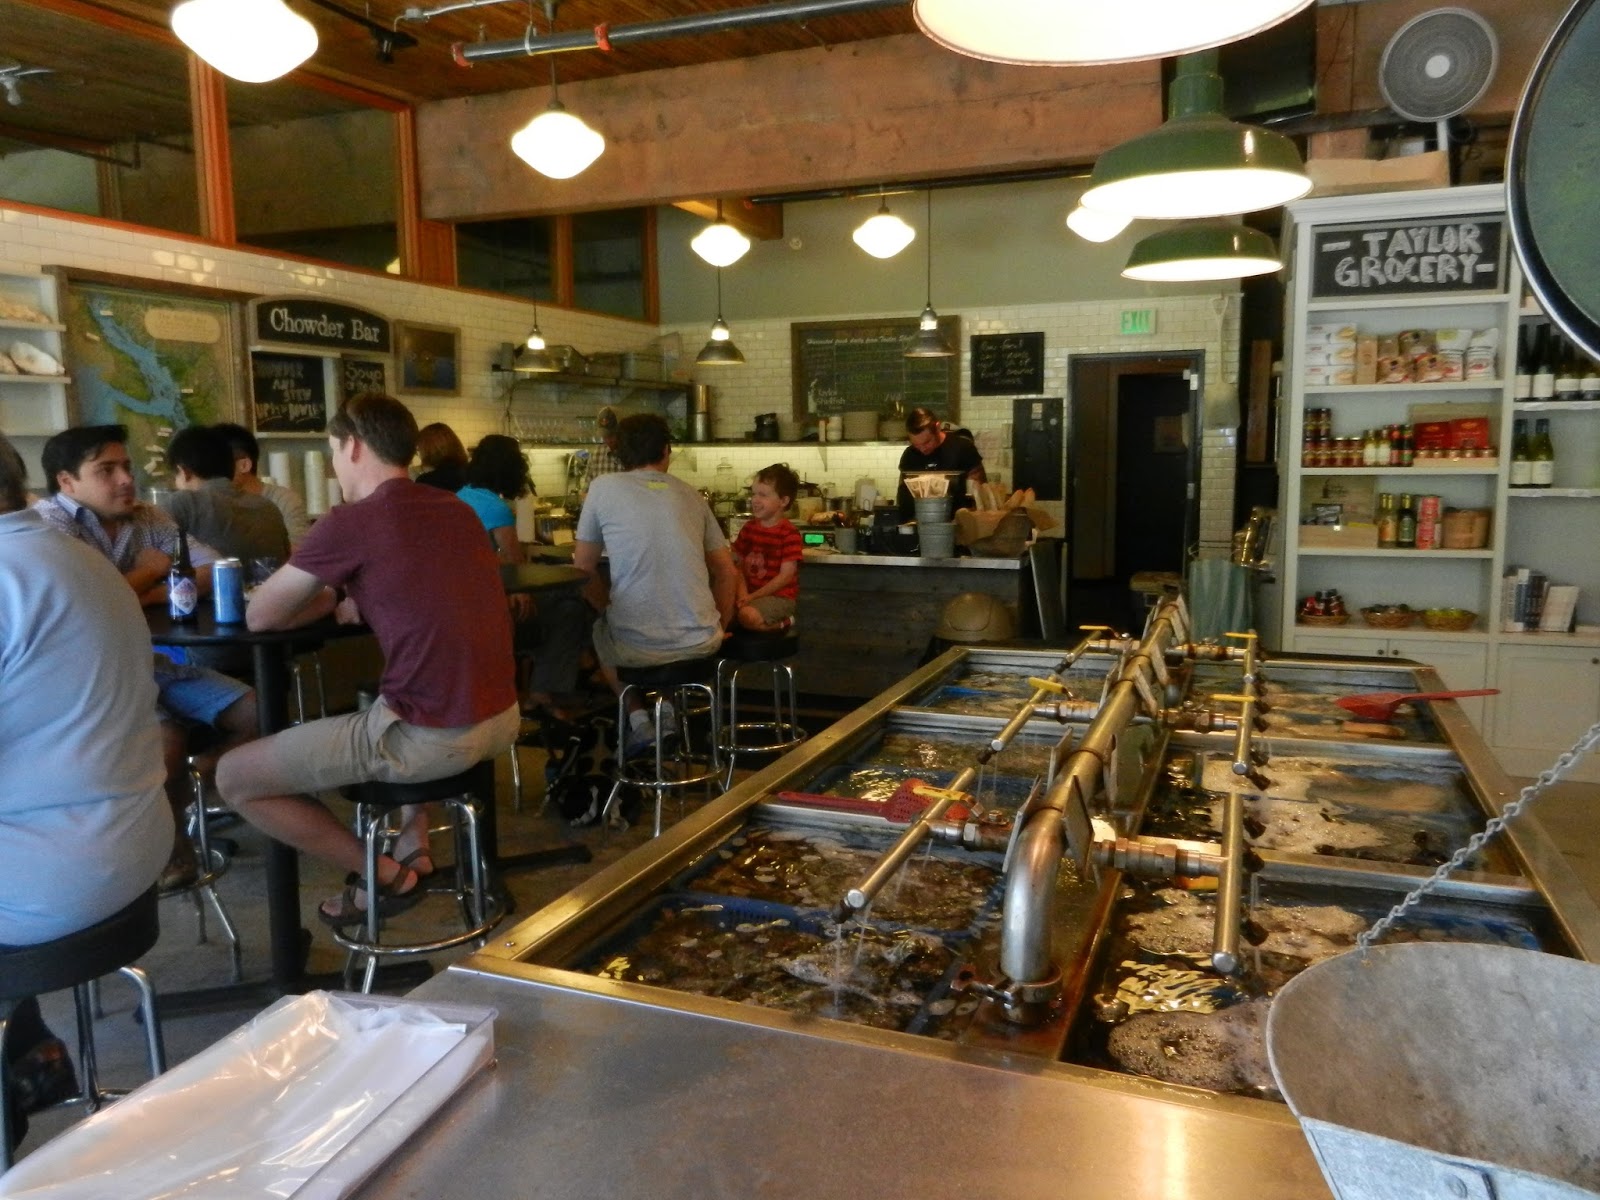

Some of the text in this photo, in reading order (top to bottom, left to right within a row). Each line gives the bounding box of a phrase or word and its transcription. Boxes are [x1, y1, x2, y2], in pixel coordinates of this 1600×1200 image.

[1362, 224, 1483, 258] TAYLOR
[270, 308, 380, 343] Chowder Bar
[1121, 311, 1151, 334] EXIT
